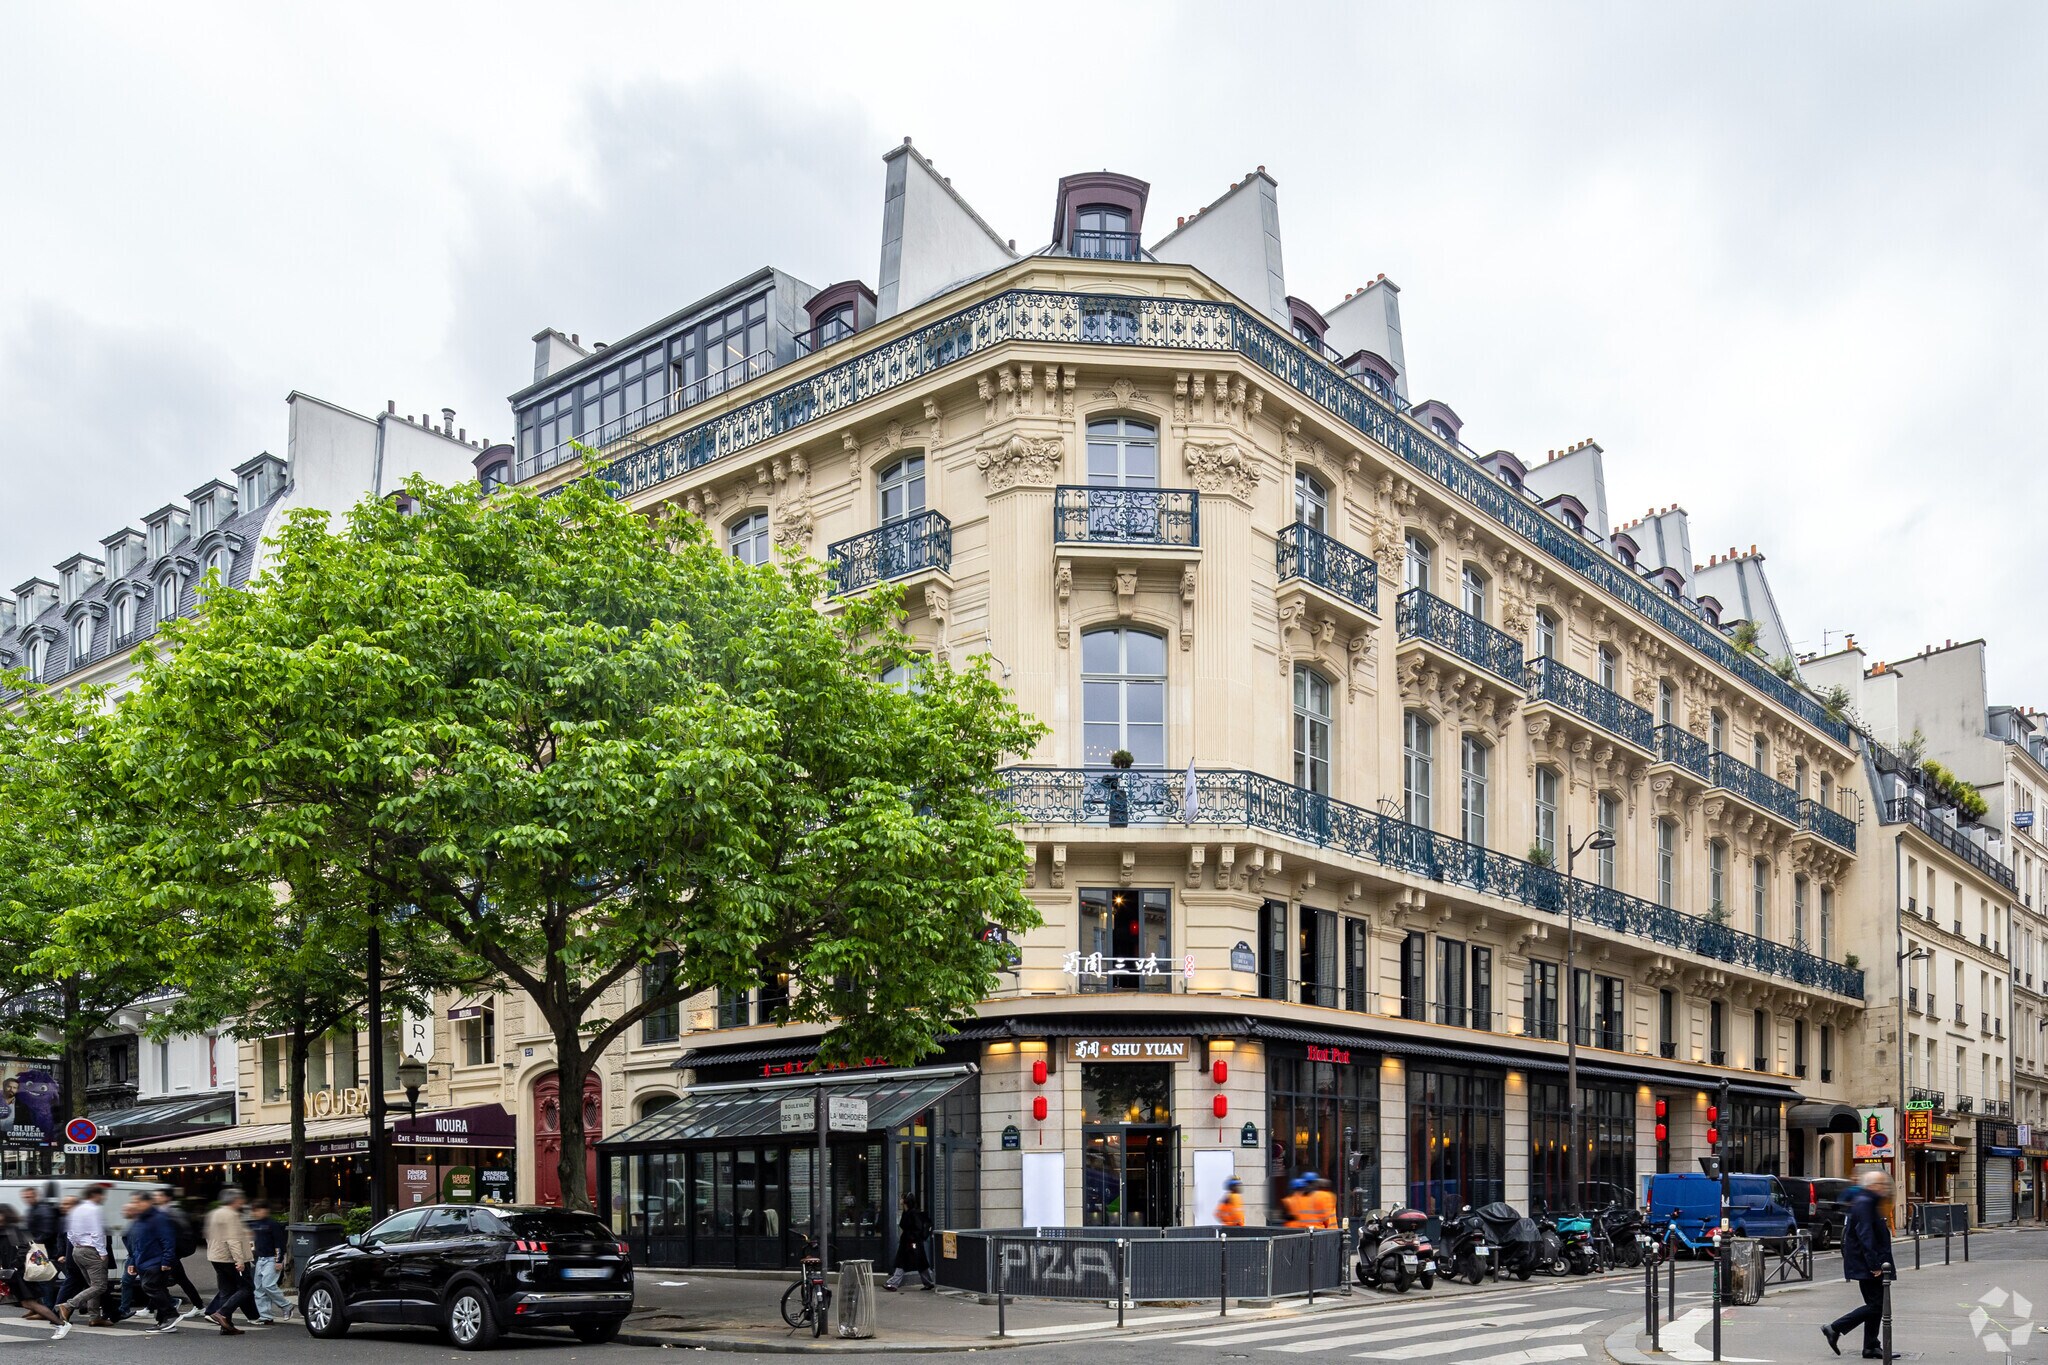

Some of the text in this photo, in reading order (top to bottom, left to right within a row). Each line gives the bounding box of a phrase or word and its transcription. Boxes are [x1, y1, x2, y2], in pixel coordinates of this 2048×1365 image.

[1111, 1043, 1141, 1056] SHU
[1144, 1043, 1184, 1056] YUAN
[1307, 1044, 1351, 1064] Hot Pot
[784, 1102, 810, 1110] BOULEVARD
[781, 1114, 791, 1122] DES
[435, 1118, 468, 1133] NOURA
